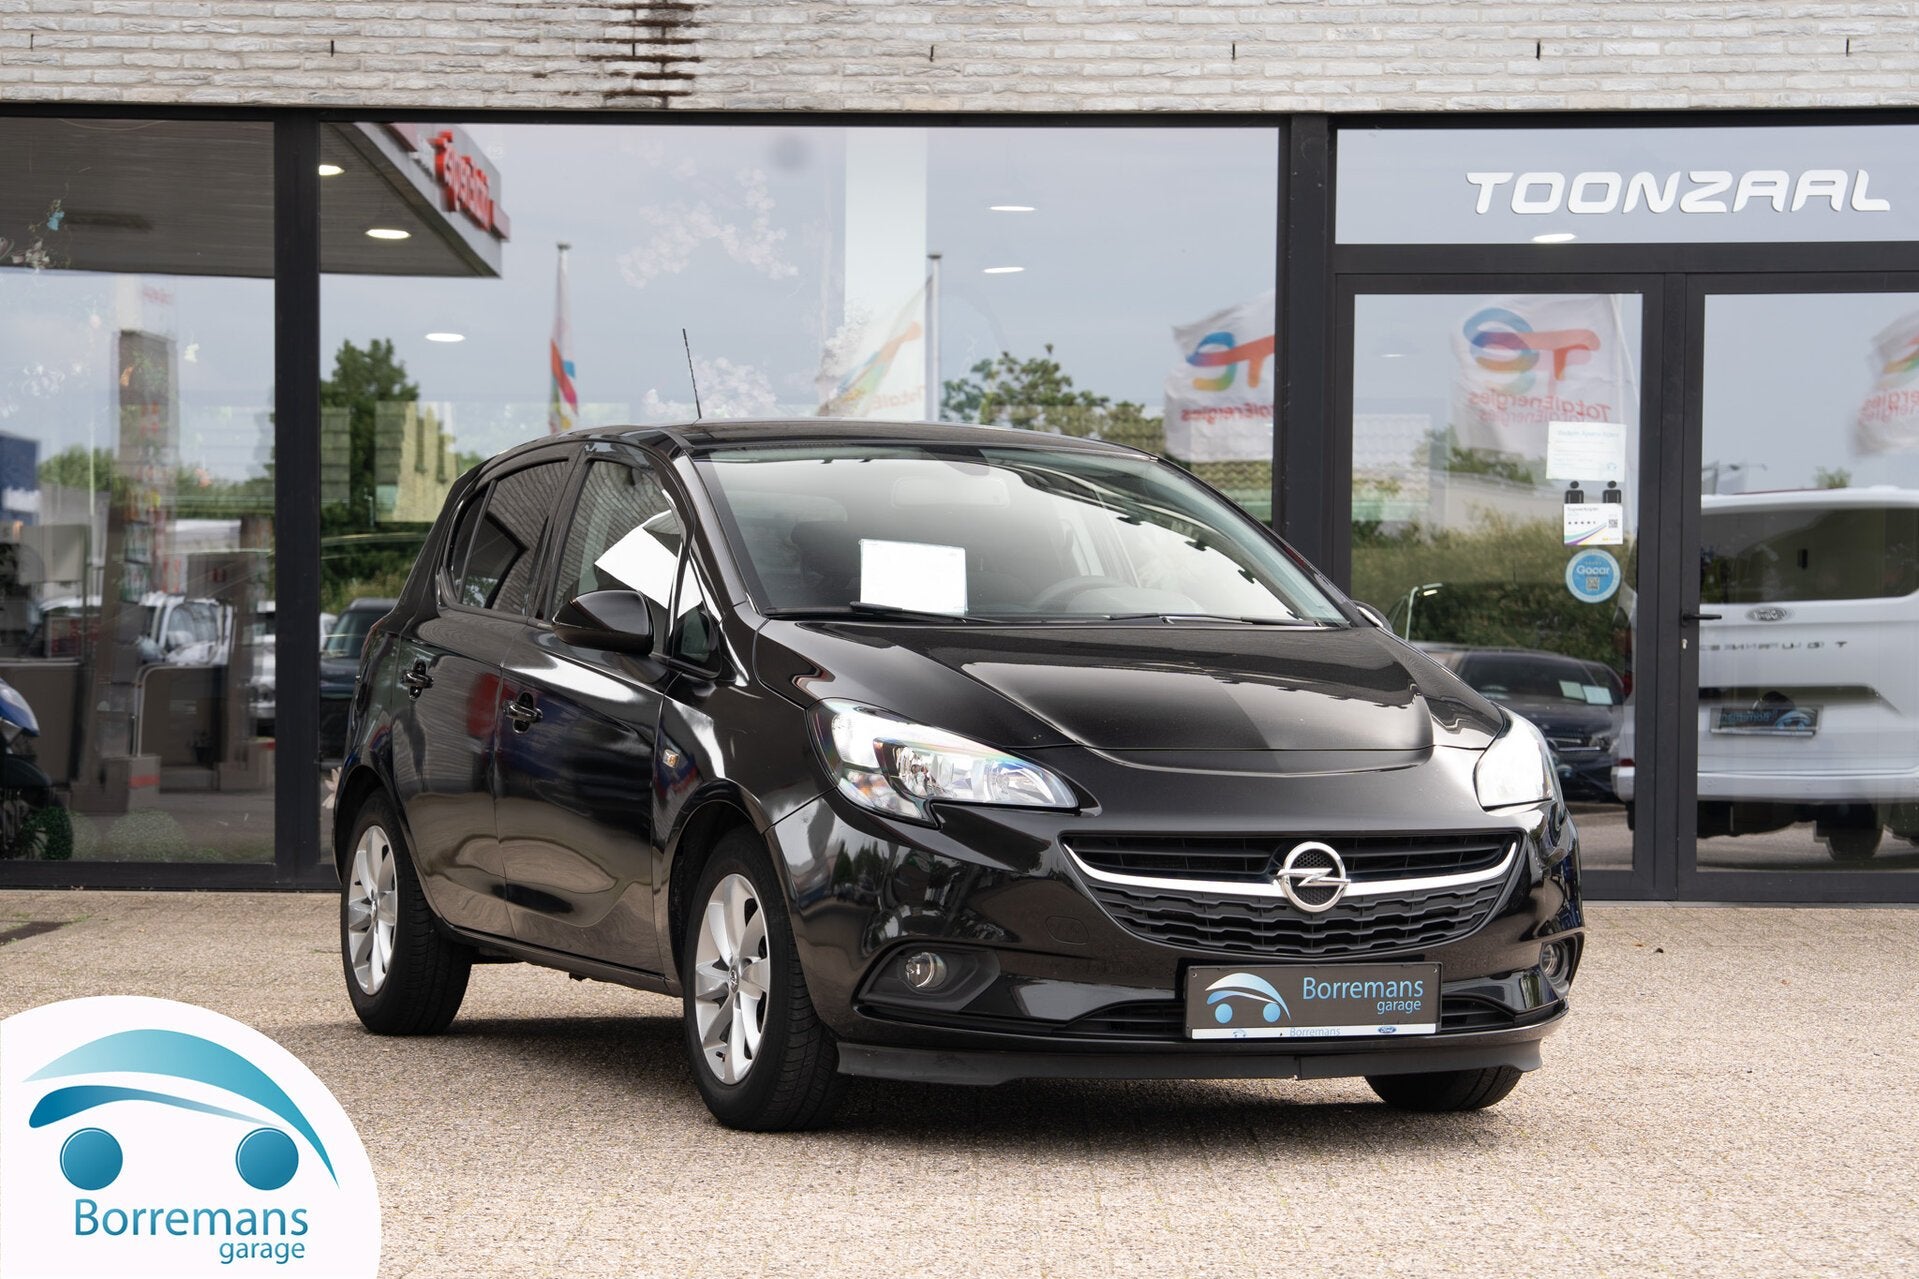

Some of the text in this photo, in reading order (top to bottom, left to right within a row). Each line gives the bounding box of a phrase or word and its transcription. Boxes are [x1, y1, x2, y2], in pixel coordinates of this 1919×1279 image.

[1465, 169, 1891, 215] TOONZAAL
[1576, 565, 1610, 575] Gocar
[1303, 977, 1424, 1000] Borremans
[1377, 999, 1422, 1015] garage
[1289, 1027, 1341, 1037] Borremans
